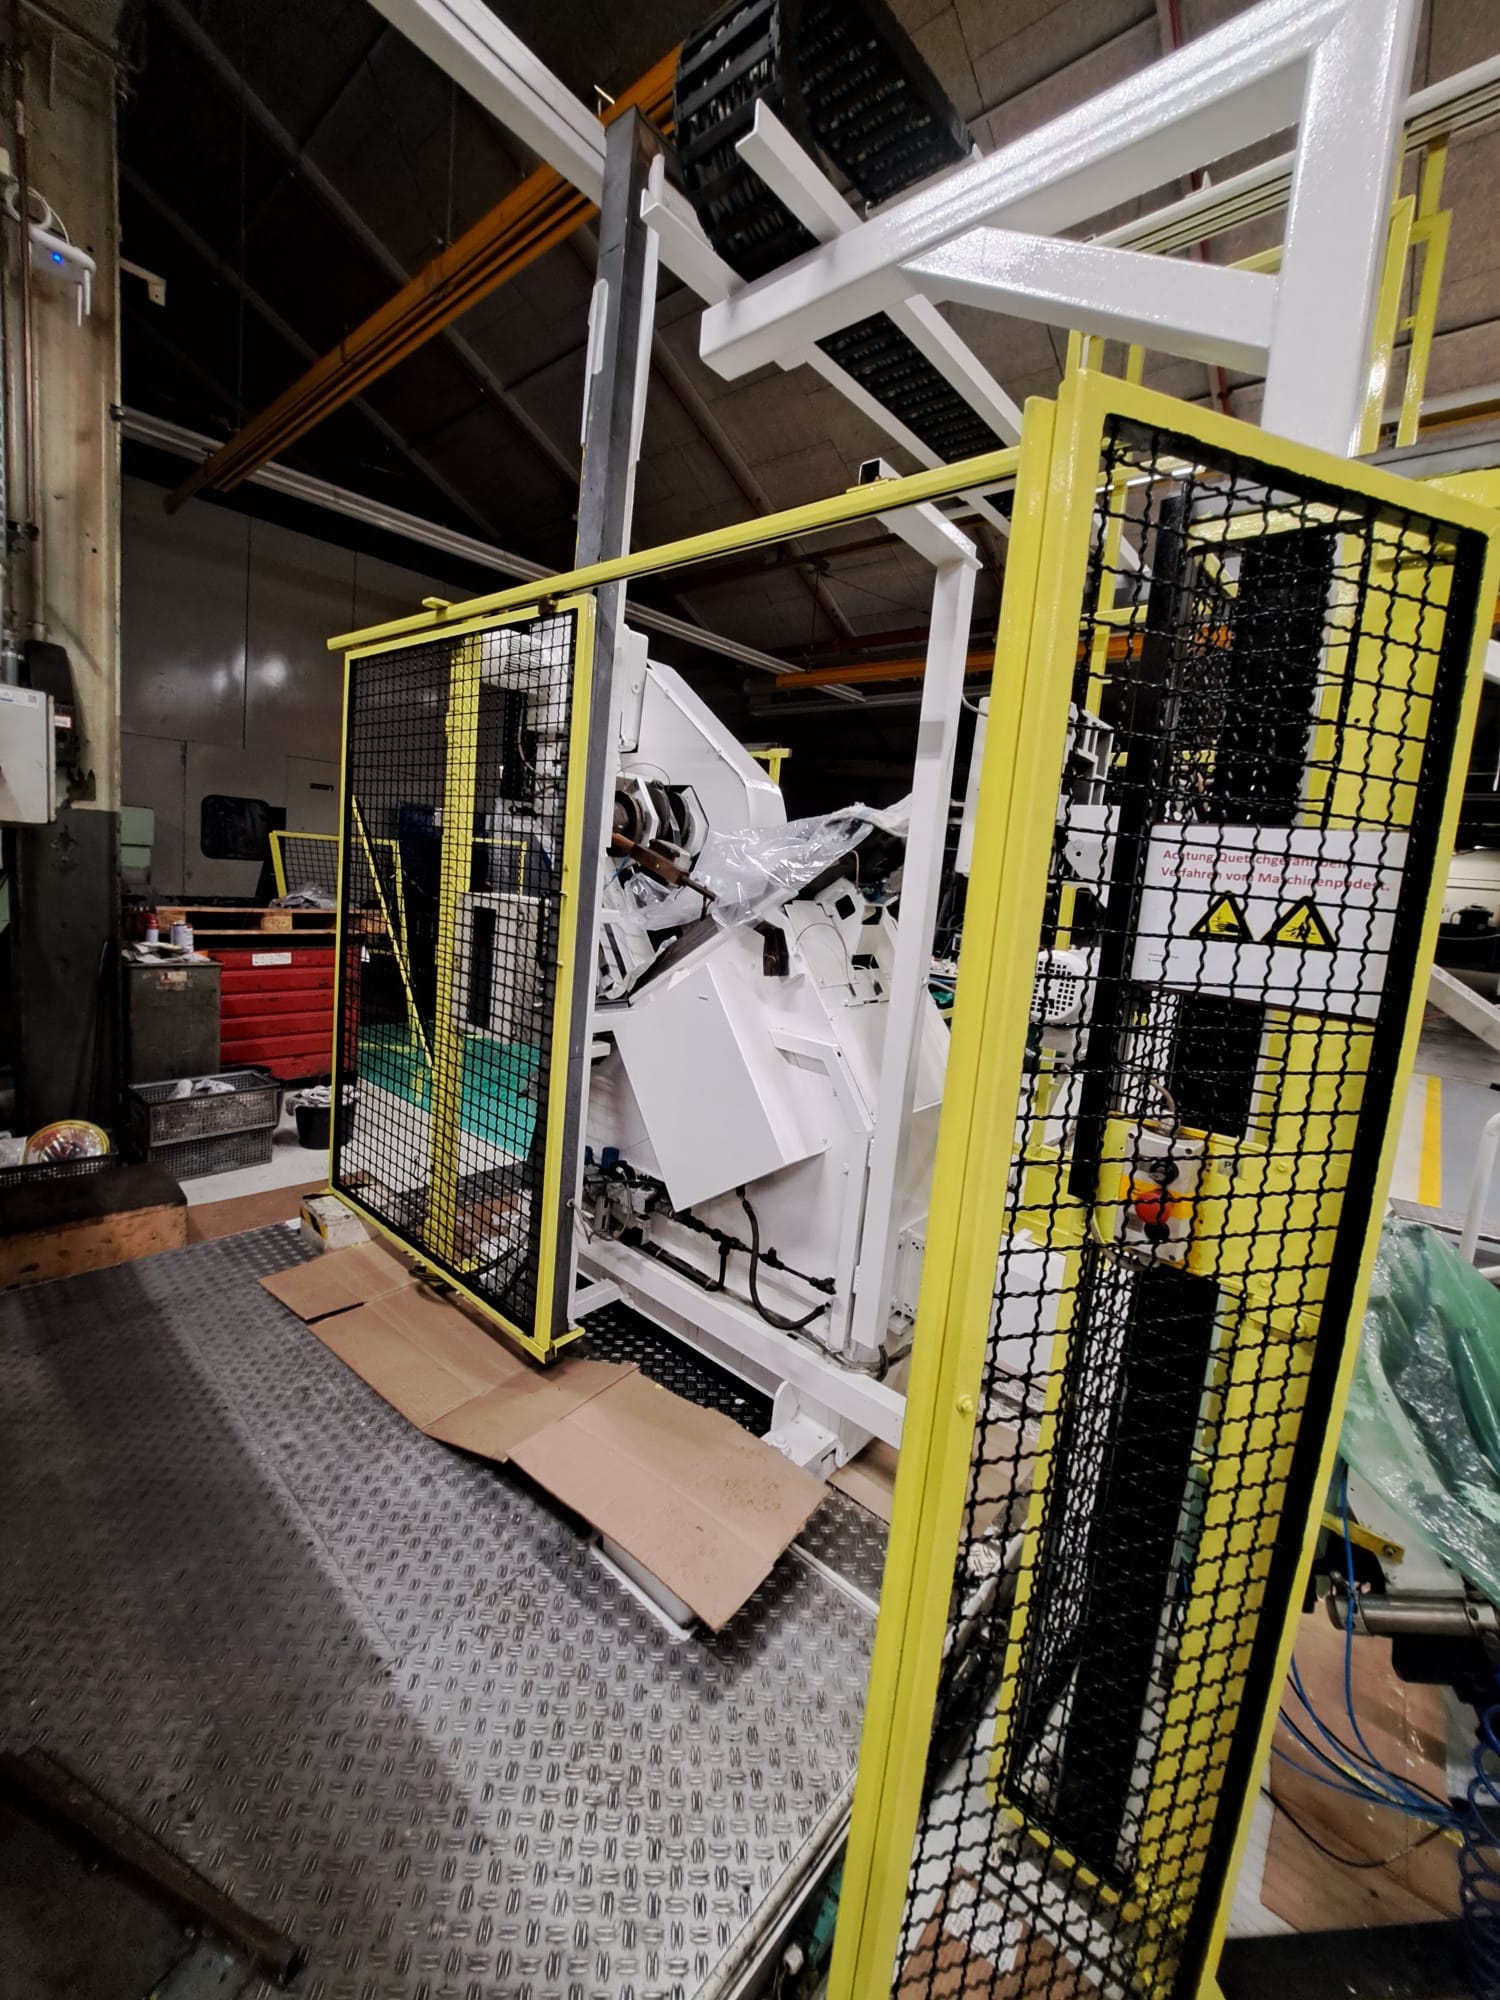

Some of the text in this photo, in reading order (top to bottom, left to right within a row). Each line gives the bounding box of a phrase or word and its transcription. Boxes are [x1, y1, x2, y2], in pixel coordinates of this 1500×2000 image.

[1163, 850, 1214, 863] Actung
[1161, 867, 1222, 880] Vefahren
[1258, 872, 1390, 892] Machinenpodest.
